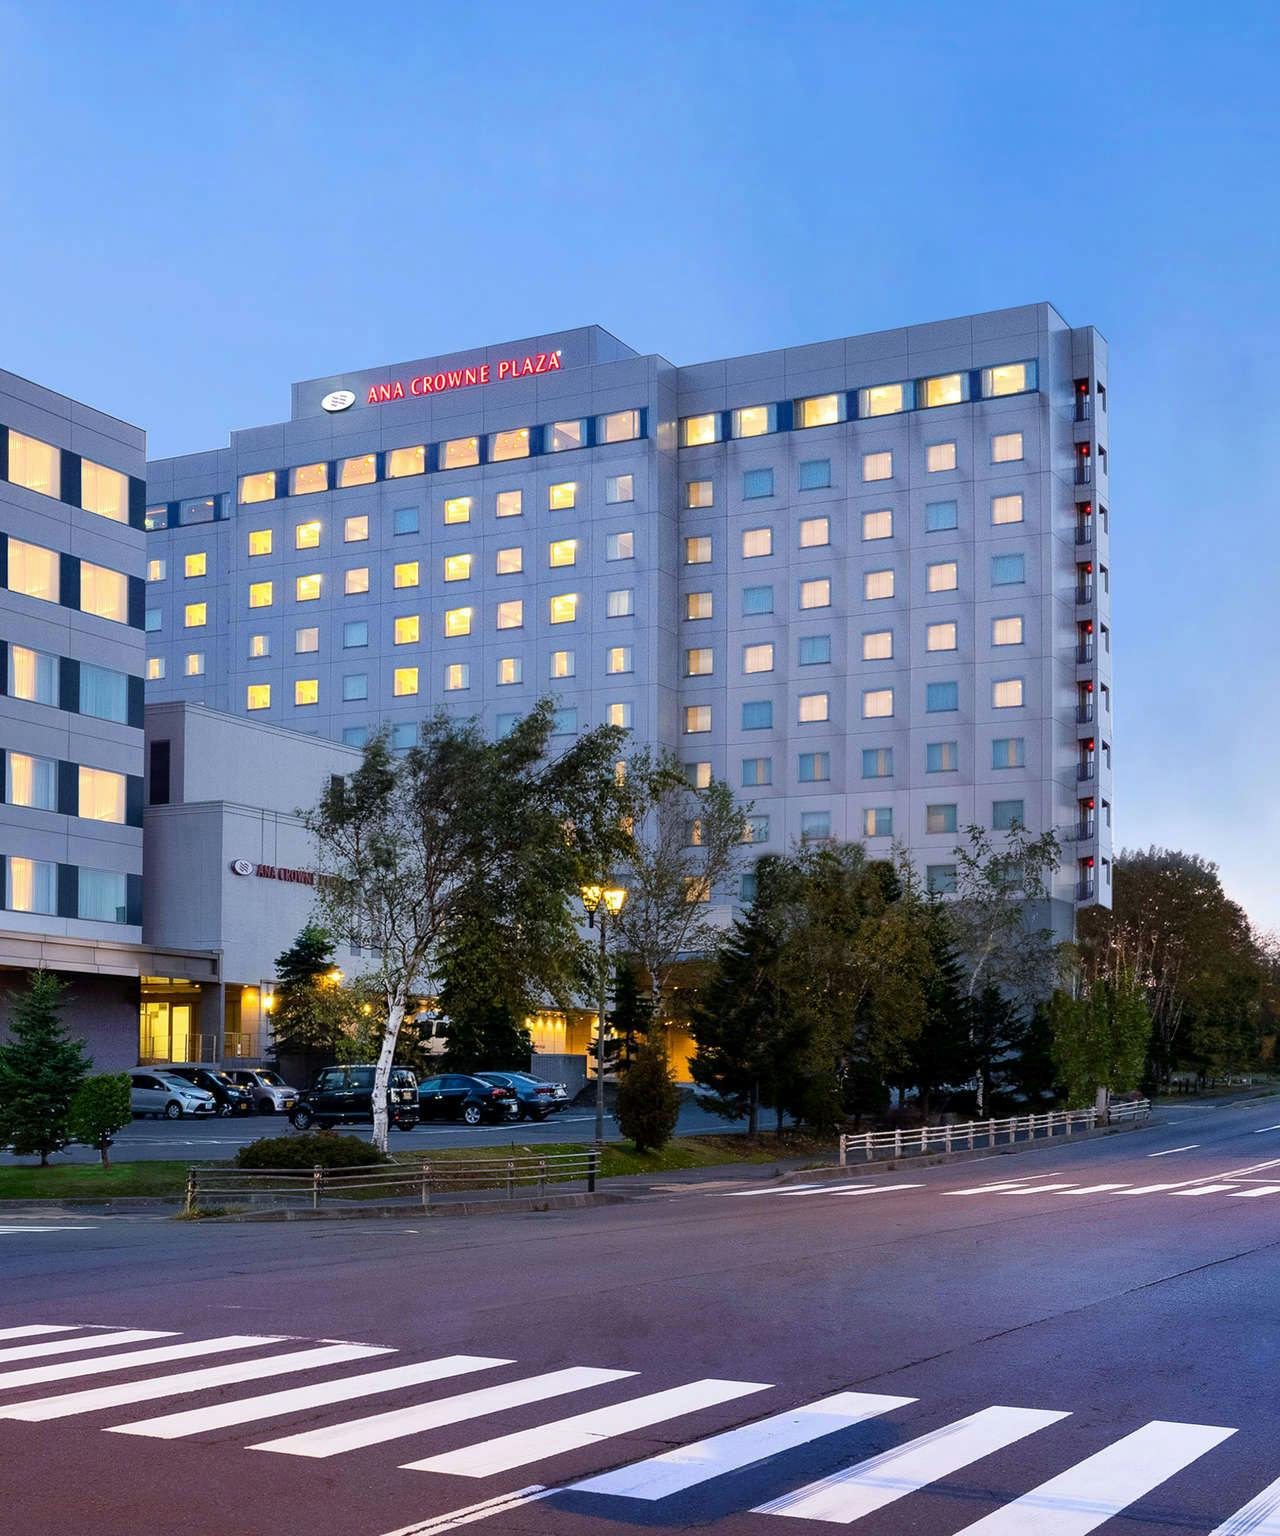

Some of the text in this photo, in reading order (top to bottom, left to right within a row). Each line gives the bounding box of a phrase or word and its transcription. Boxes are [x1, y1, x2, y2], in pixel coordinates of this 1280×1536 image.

[368, 352, 560, 403] ANA CROWNE PLAZA
[256, 864, 276, 879] ANA
